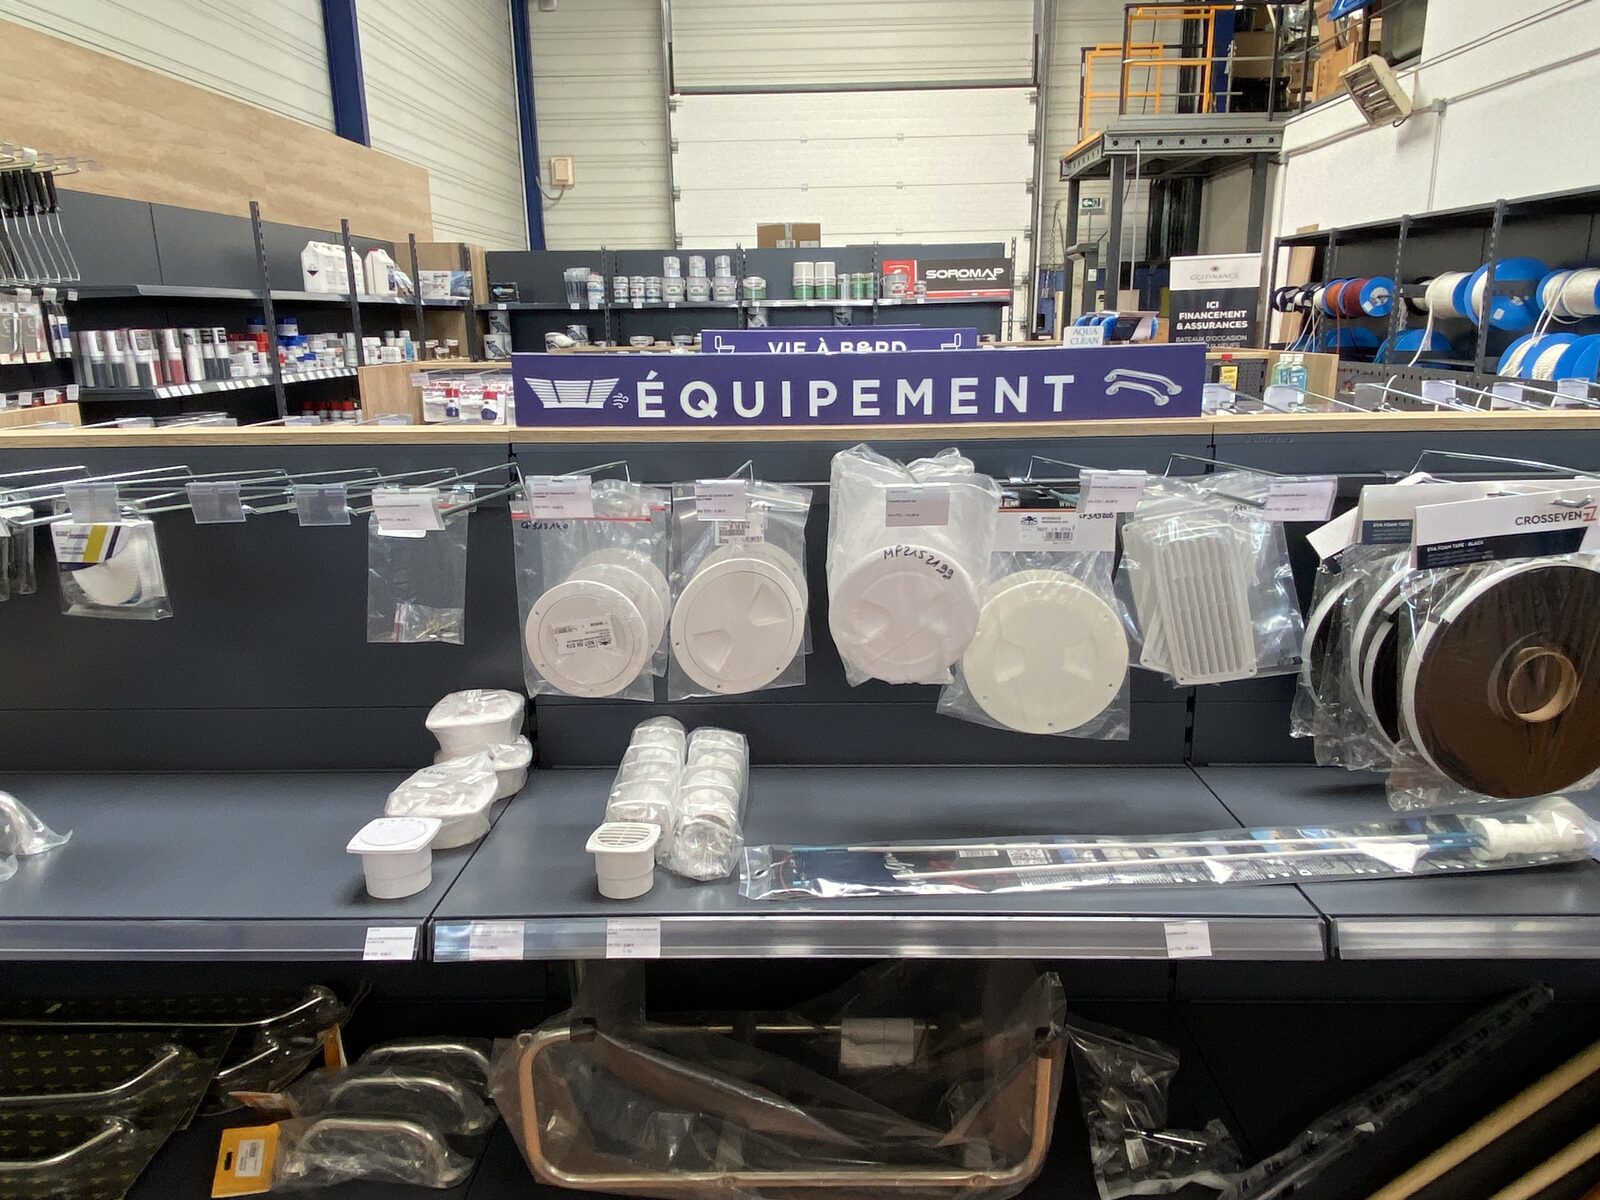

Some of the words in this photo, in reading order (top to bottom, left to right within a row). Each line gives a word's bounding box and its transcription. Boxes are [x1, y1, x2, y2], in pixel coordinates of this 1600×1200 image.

[925, 268, 1004, 280] SOROMAP
[1206, 301, 1219, 309] ICI
[1179, 310, 1247, 320] FINANCEMENT
[1184, 320, 1248, 330] ASSURANCES
[1073, 328, 1098, 338] AQUA
[1205, 334, 1247, 342] D'OCCASION
[1071, 337, 1099, 345] CLEAN
[636, 371, 1076, 419] ÉQUIPEMENT
[1515, 510, 1583, 526] CROSSEVEN
